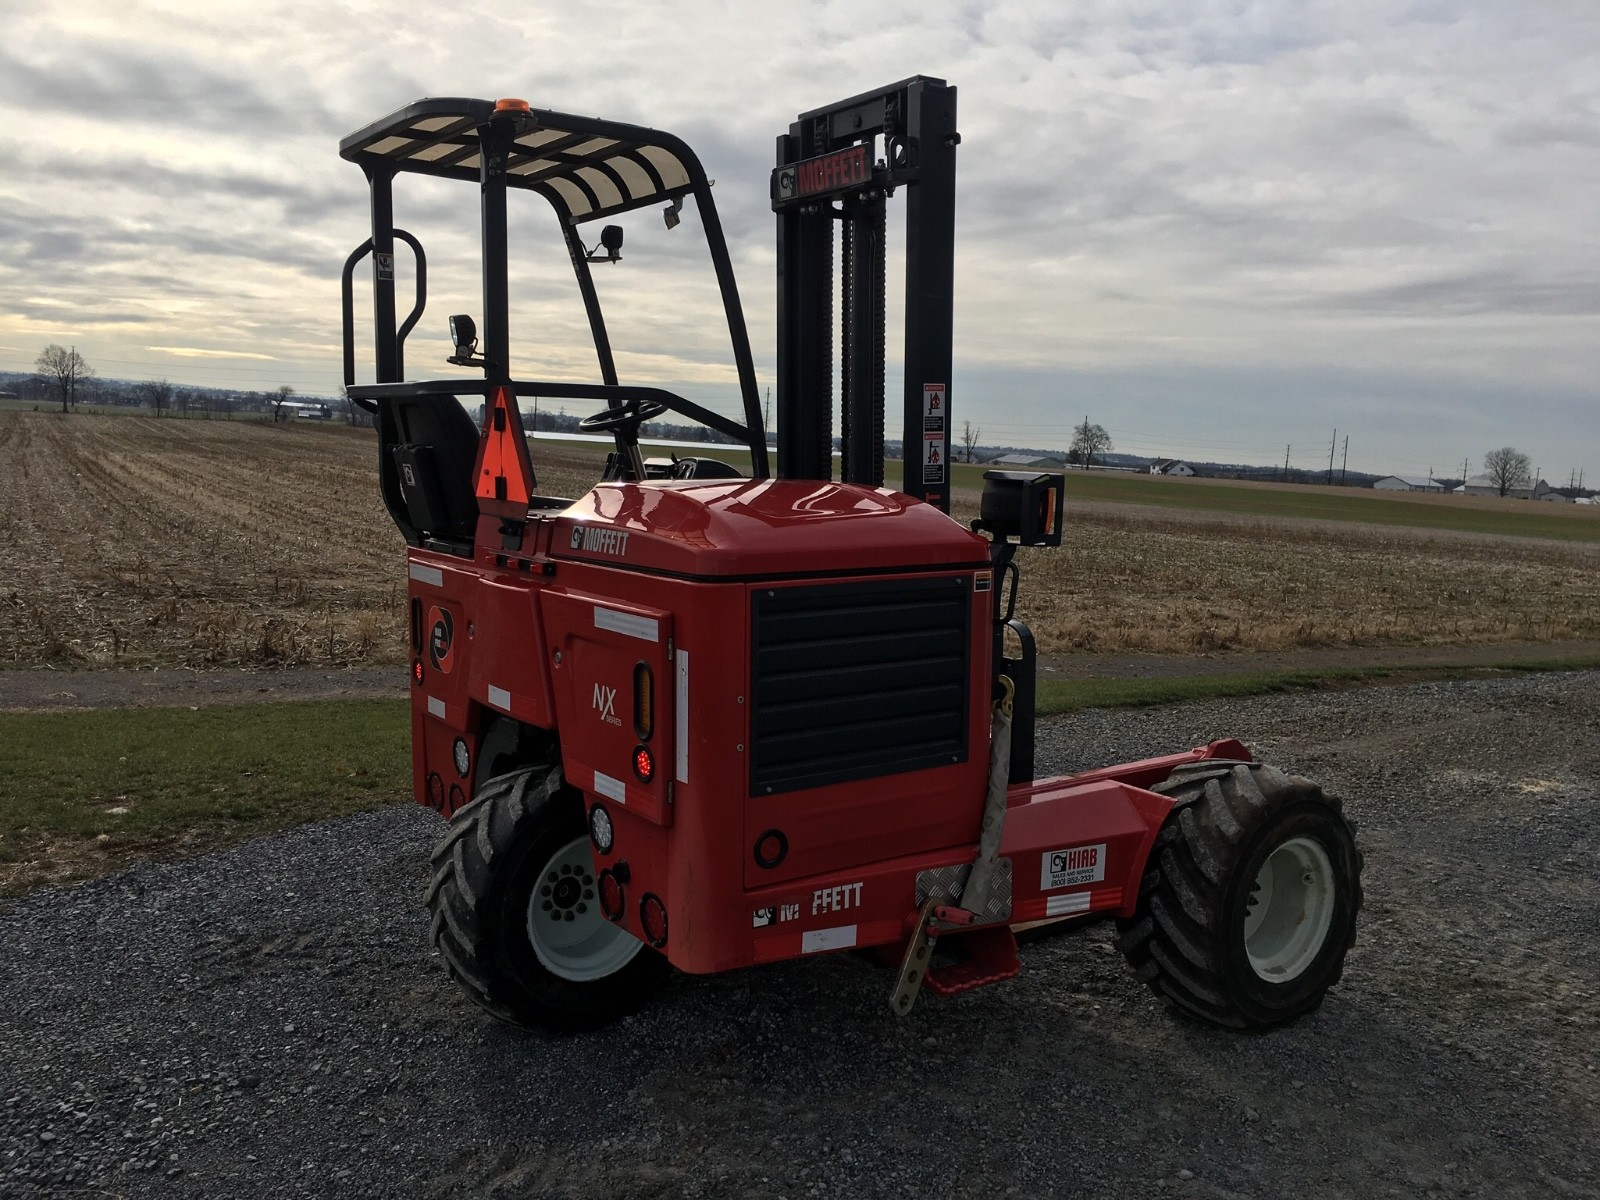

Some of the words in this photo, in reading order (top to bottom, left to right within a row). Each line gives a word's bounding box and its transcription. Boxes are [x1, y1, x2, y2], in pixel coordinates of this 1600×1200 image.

[798, 147, 865, 193] MOFFETT
[583, 527, 629, 556] MOFFETT
[592, 683, 617, 720] NX
[606, 714, 622, 727] SERIES
[1068, 848, 1098, 870] HIAB
[1051, 878, 1066, 887] (800)
